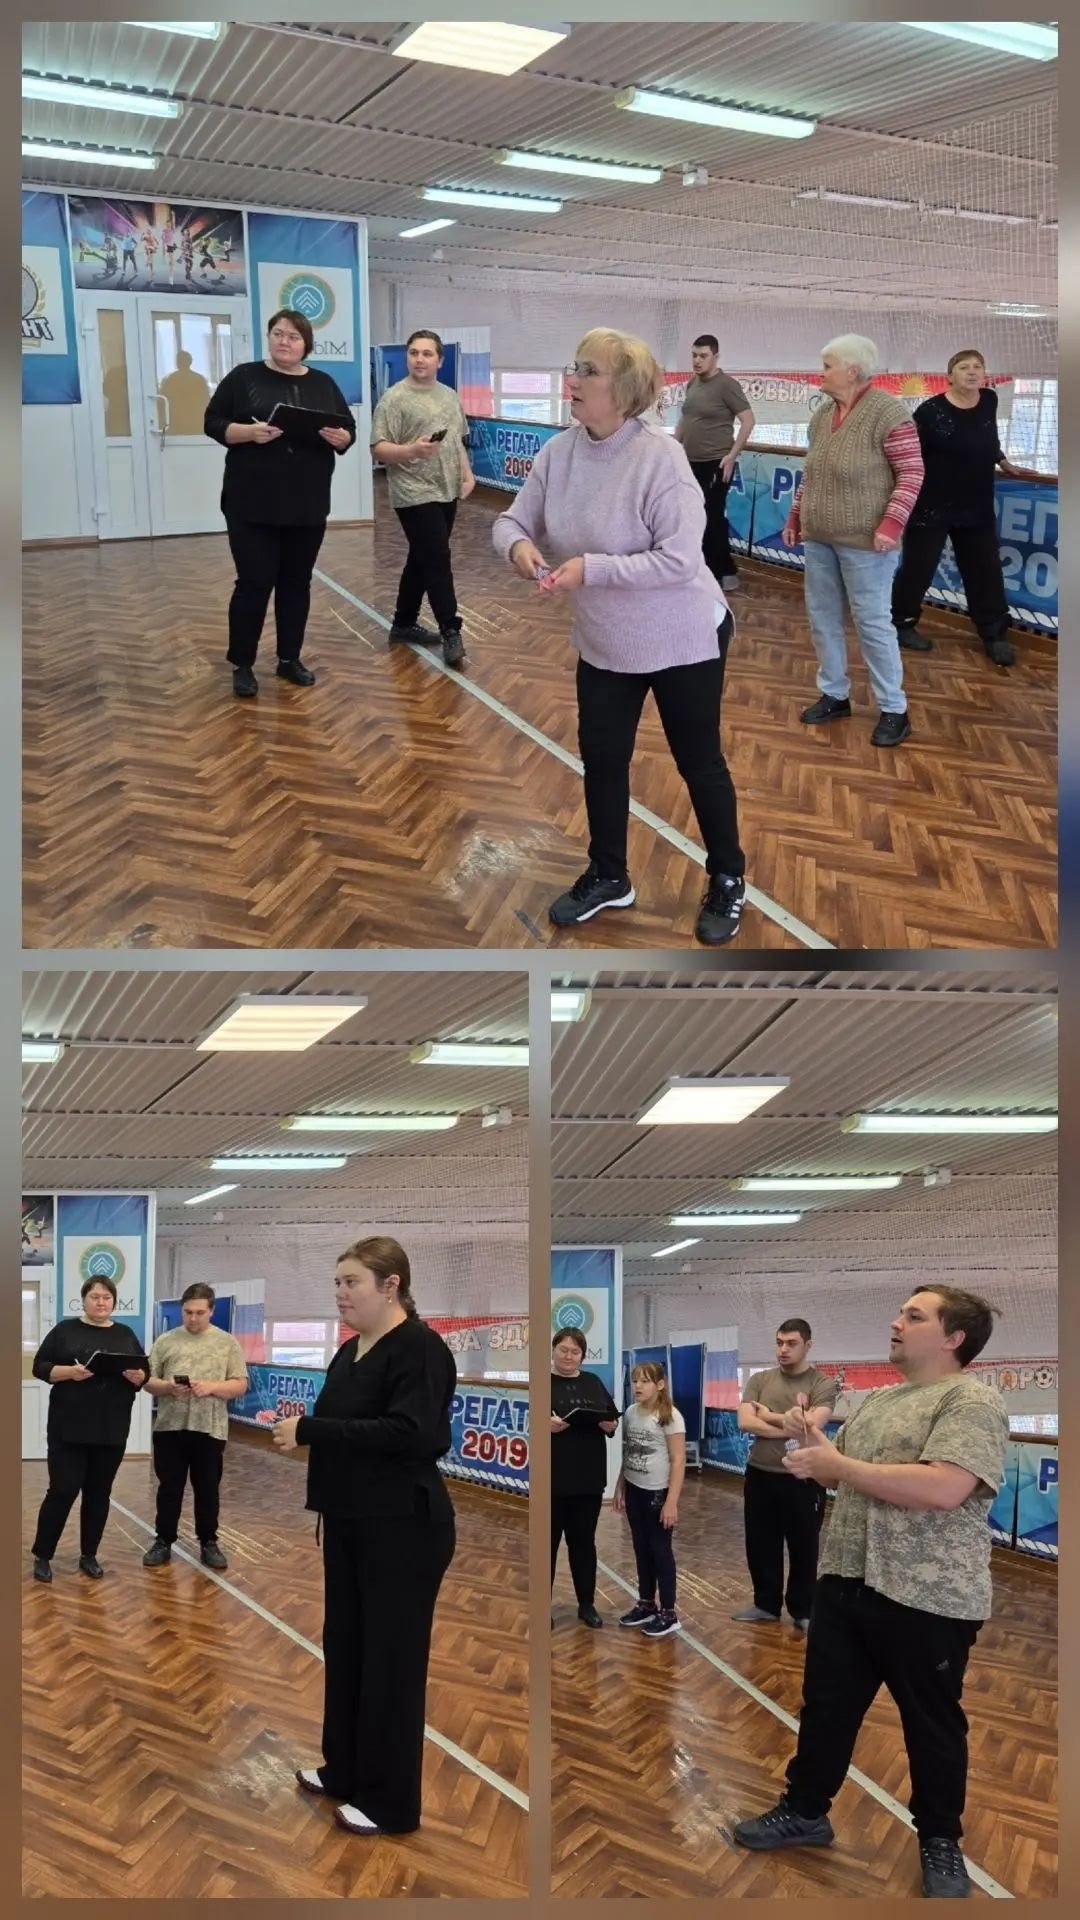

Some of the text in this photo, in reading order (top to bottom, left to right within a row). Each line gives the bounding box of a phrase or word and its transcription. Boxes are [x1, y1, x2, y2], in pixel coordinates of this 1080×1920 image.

[497, 427, 542, 459] РЕГАТА
[993, 496, 1058, 548] ЕГ
[268, 1372, 317, 1402] РЕГАТА
[449, 1393, 530, 1434] РЕГАТ
[461, 1428, 530, 1470] 2019
